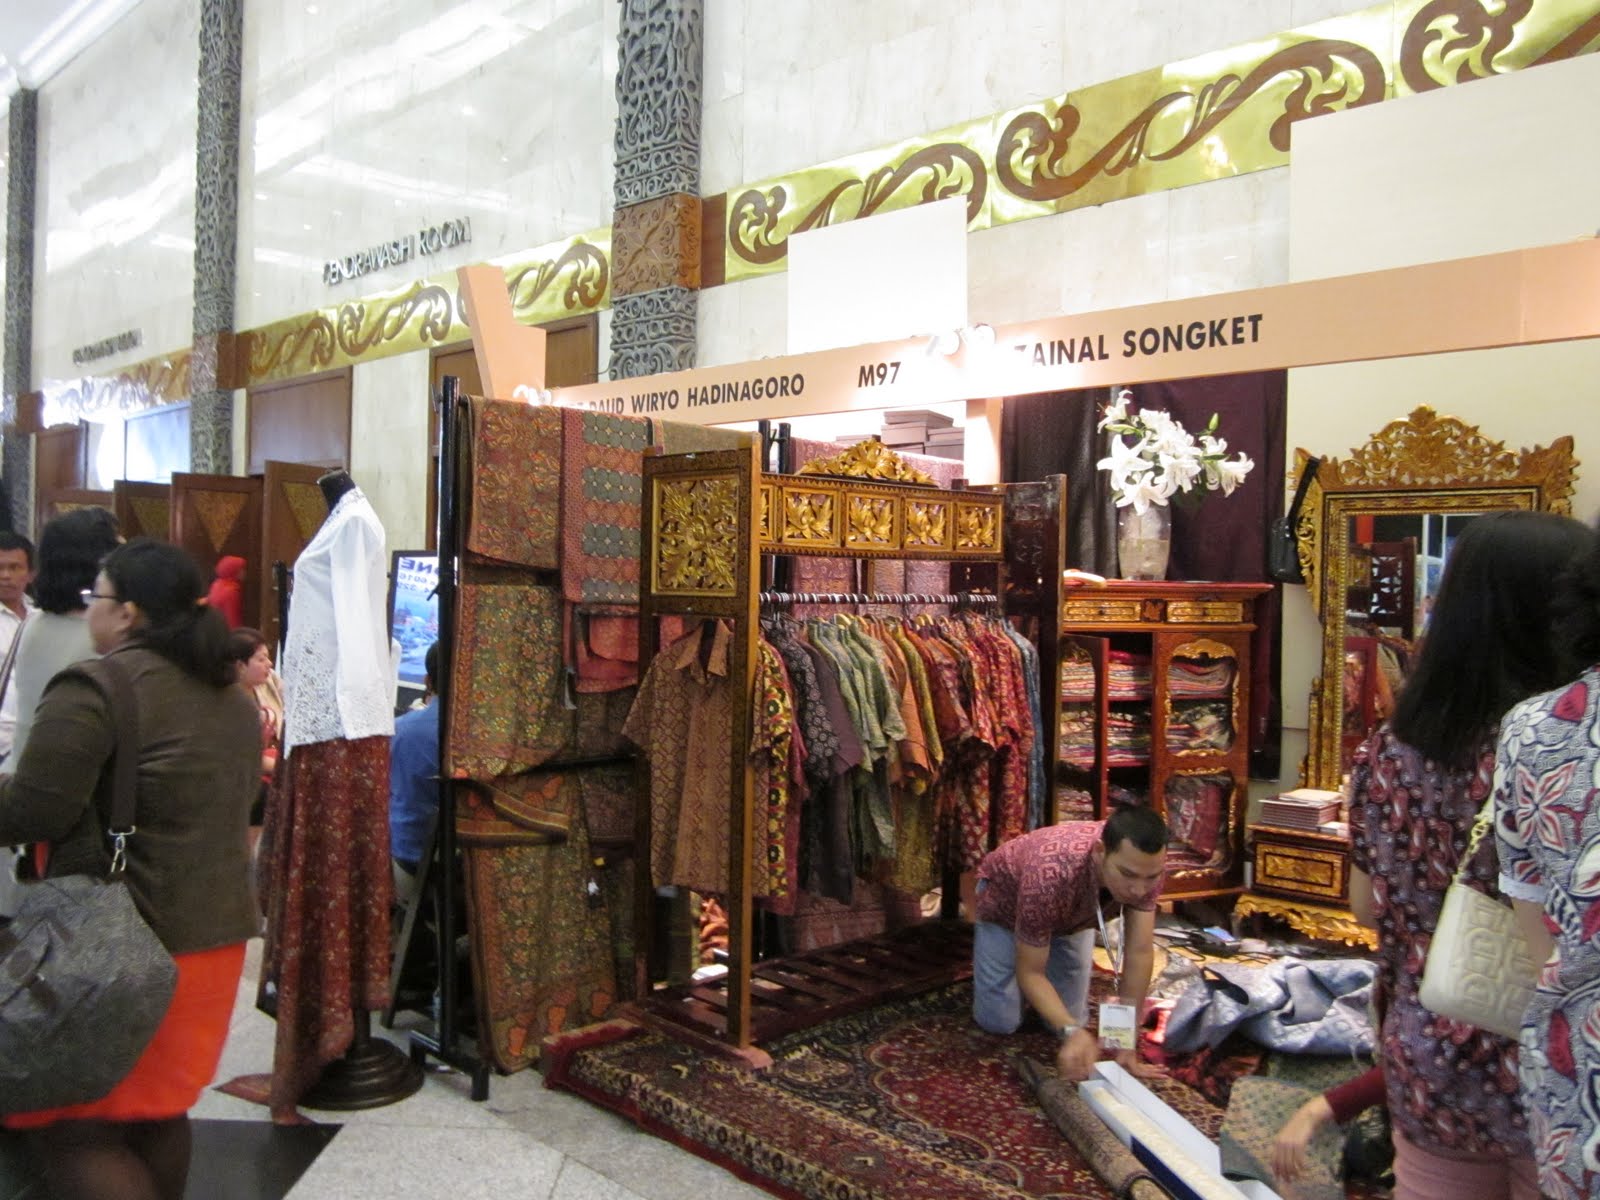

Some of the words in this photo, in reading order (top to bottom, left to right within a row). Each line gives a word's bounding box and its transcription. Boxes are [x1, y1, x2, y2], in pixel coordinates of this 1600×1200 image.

[419, 216, 471, 256] ROOM
[1123, 314, 1263, 358] SONGKET
[631, 389, 679, 413] WIRYO
[687, 373, 805, 408] HADINAGORO
[858, 361, 901, 388] M97
